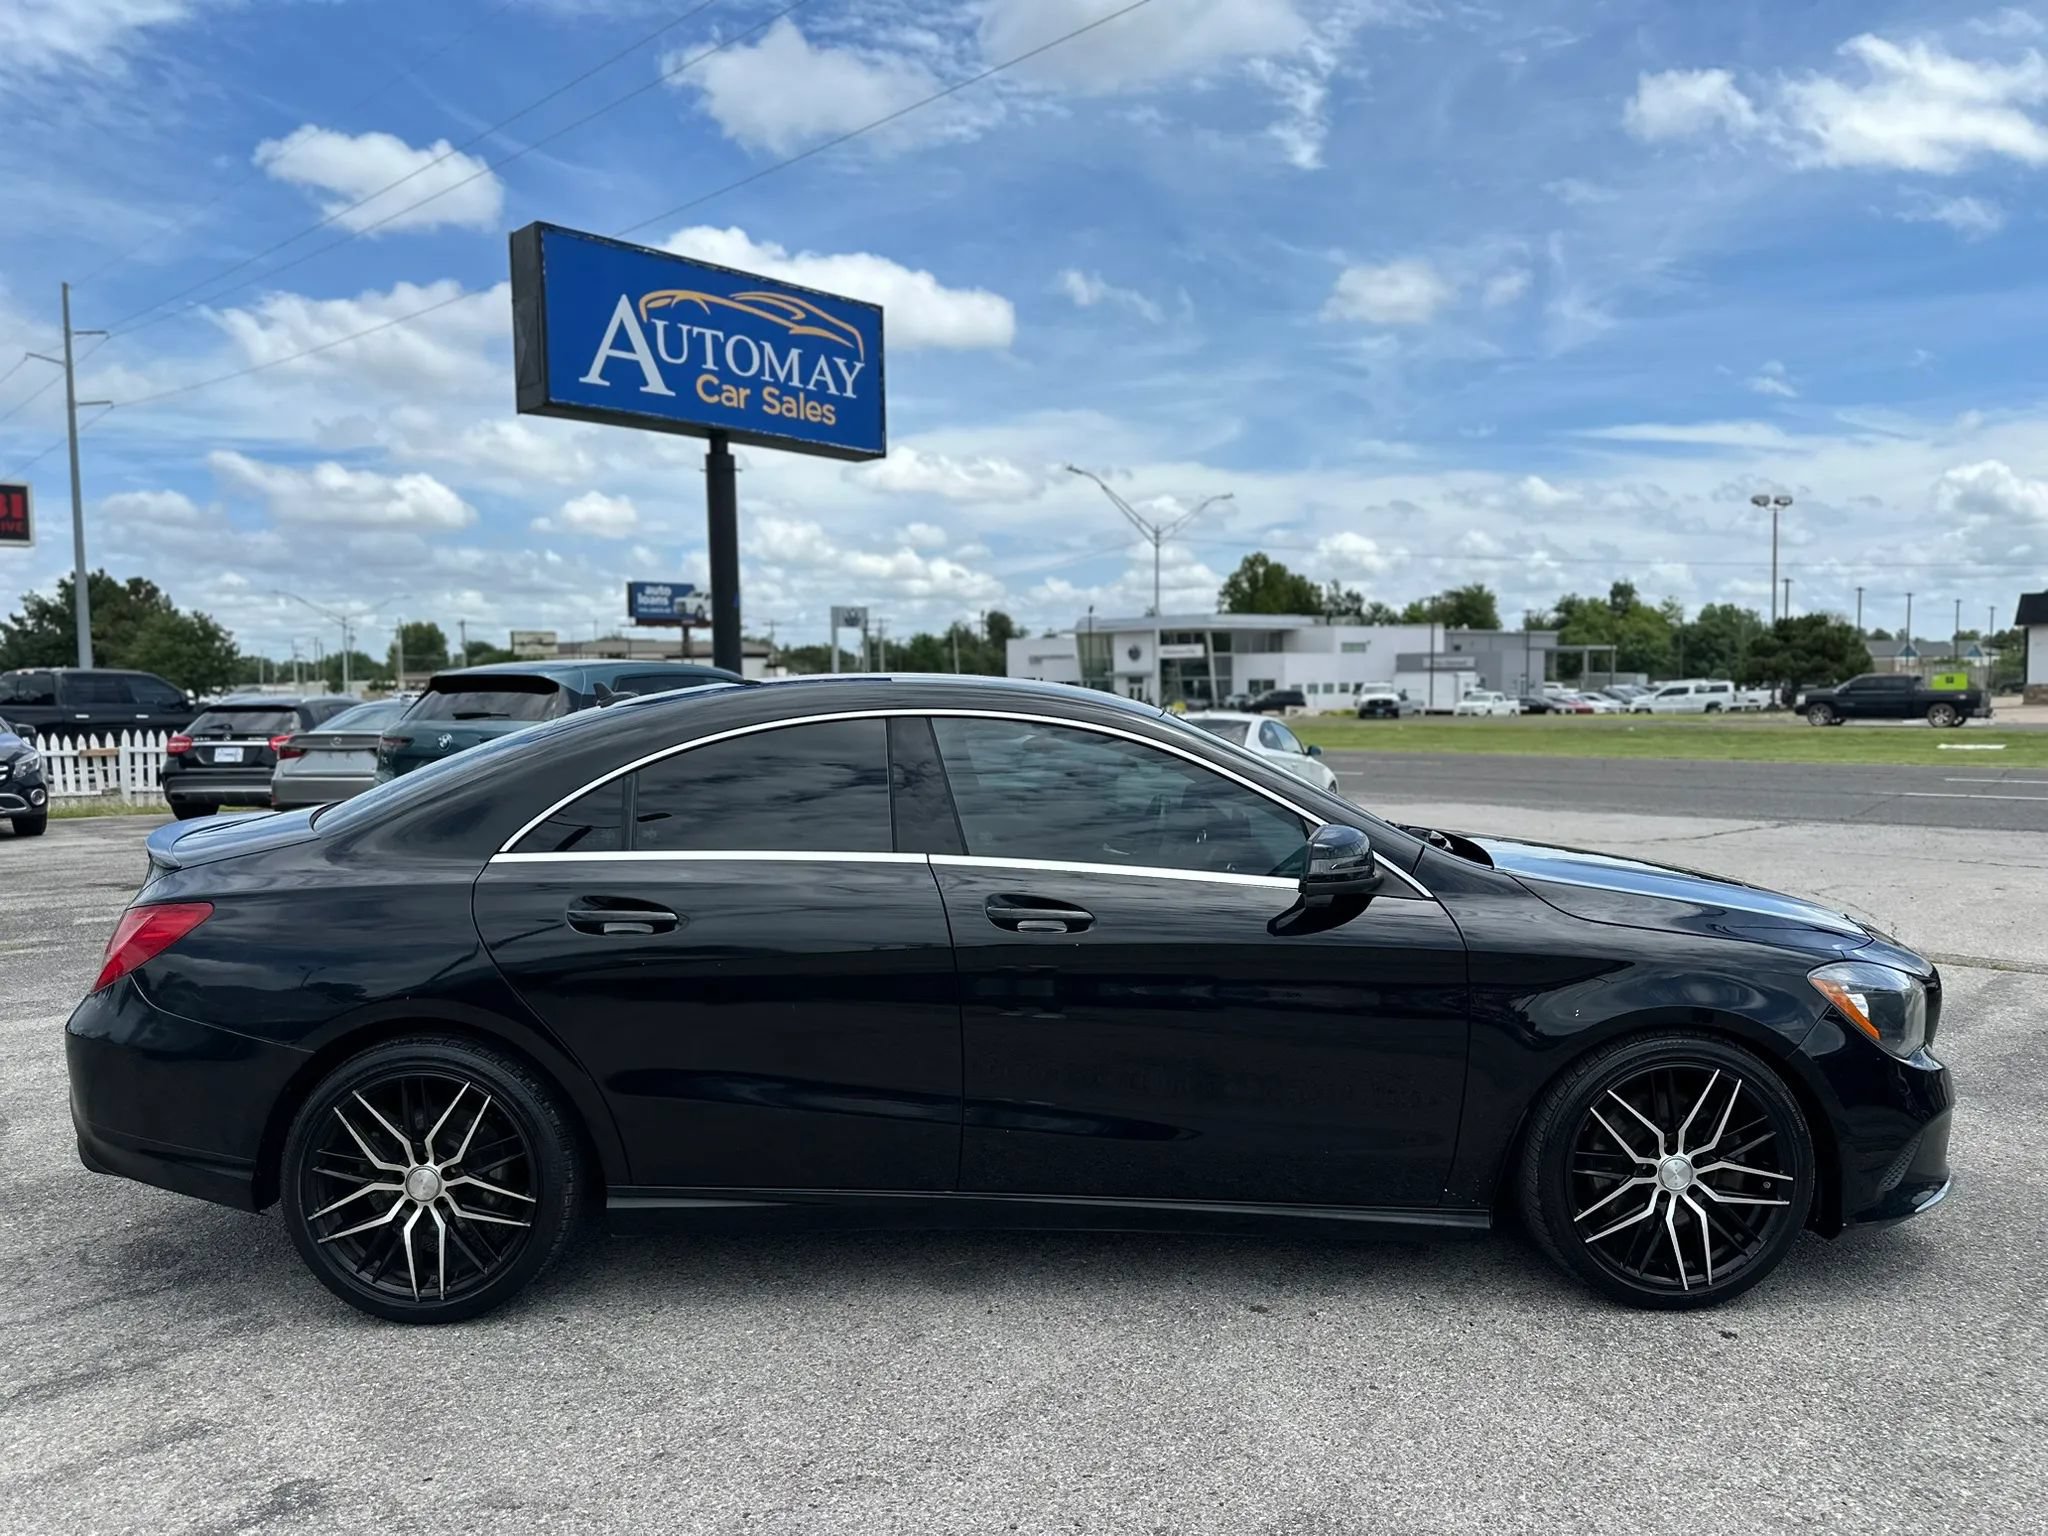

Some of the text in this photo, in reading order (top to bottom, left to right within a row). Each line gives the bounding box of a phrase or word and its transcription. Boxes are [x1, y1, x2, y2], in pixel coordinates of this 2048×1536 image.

[696, 374, 836, 426] Car Sales
[645, 585, 672, 597] auto
[637, 592, 669, 606] loans
